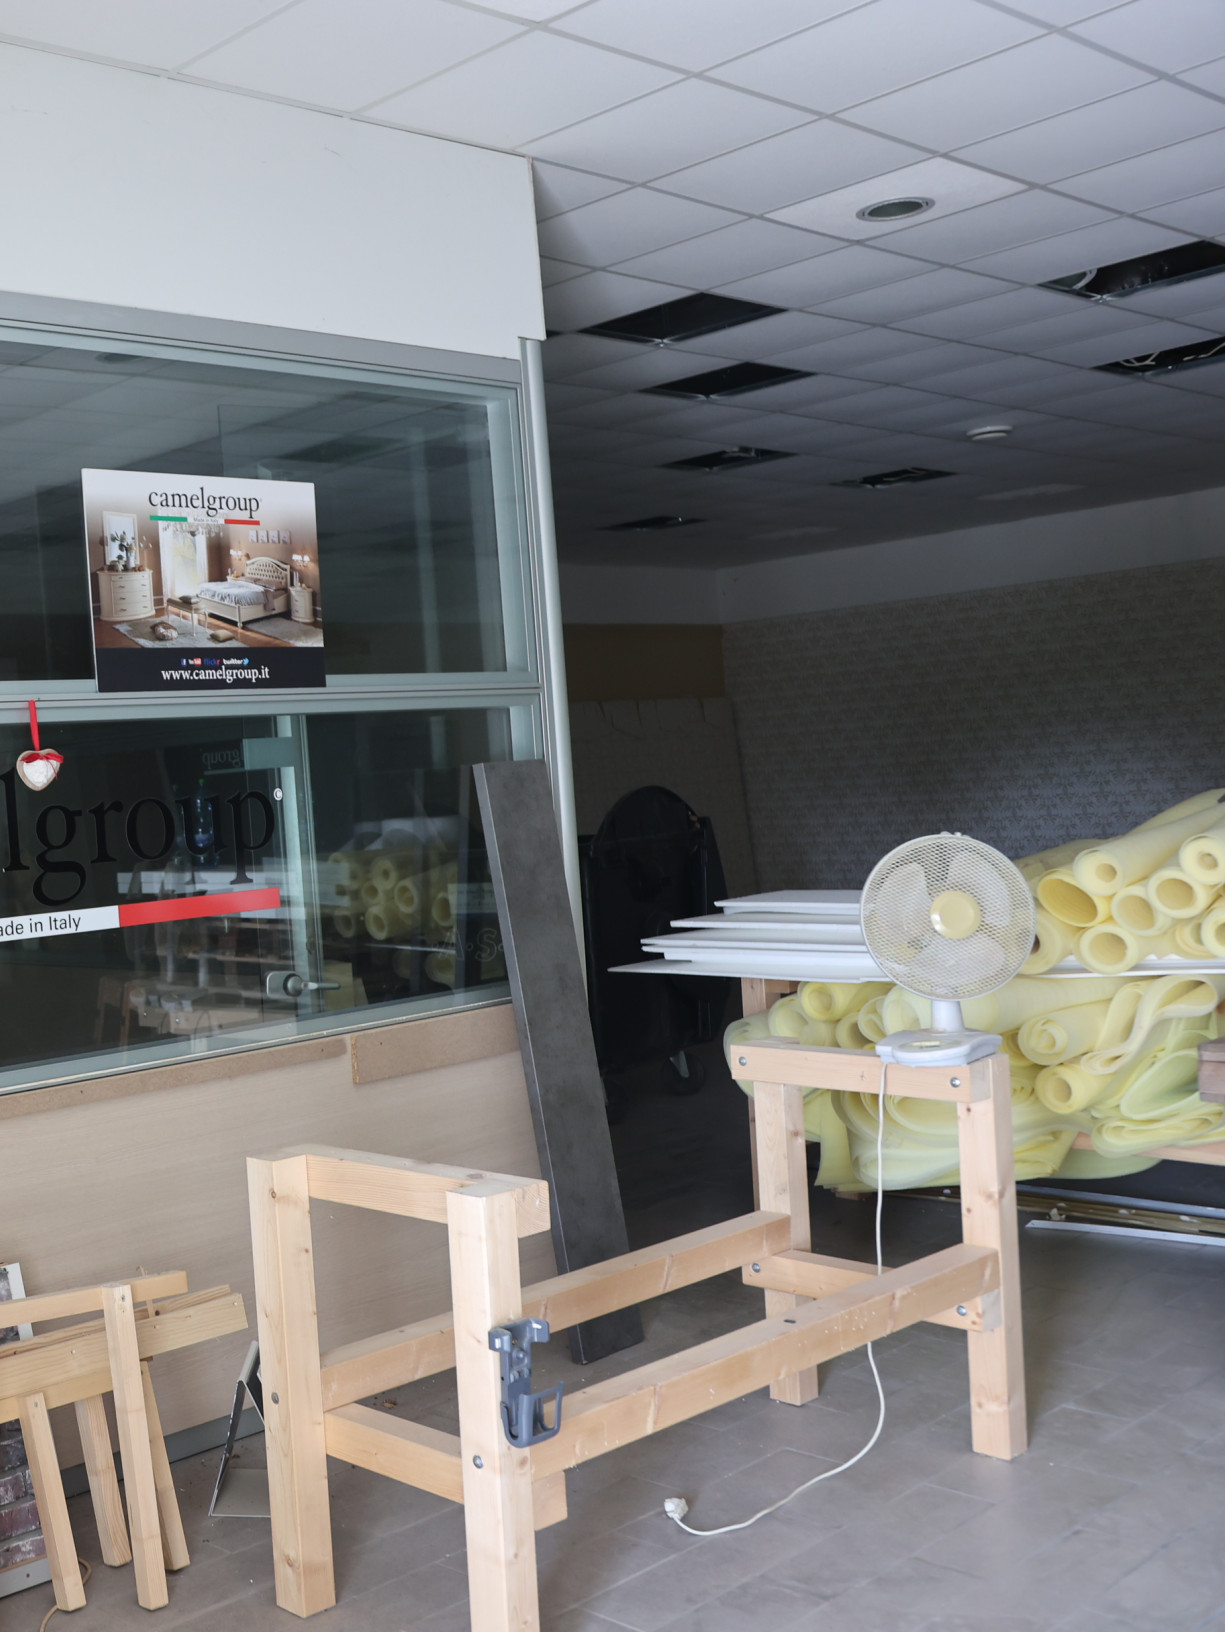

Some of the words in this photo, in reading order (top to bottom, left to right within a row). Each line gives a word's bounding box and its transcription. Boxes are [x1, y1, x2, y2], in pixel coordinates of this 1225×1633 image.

[148, 487, 260, 519] camelgroup
[161, 665, 270, 684] www.camelgroup.it
[28, 917, 45, 934] in
[48, 913, 82, 933] Italy
